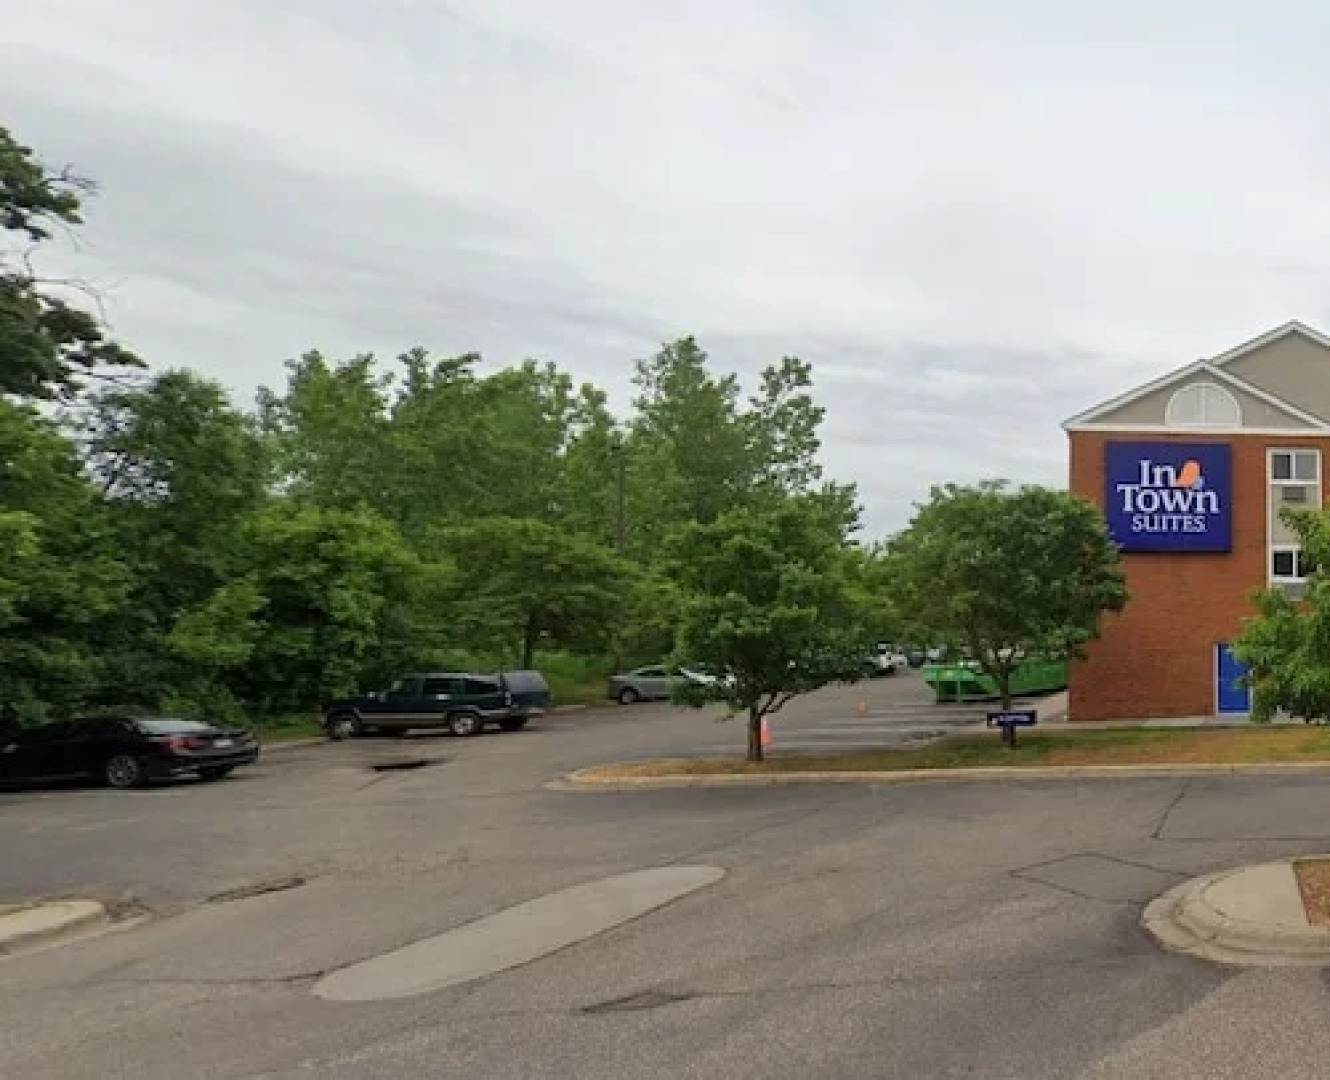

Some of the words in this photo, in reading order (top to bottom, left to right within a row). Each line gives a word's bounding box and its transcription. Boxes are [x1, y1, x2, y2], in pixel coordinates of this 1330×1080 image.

[1139, 460, 1178, 487] In
[1117, 483, 1220, 514] Town
[1132, 514, 1206, 532] SUITES
